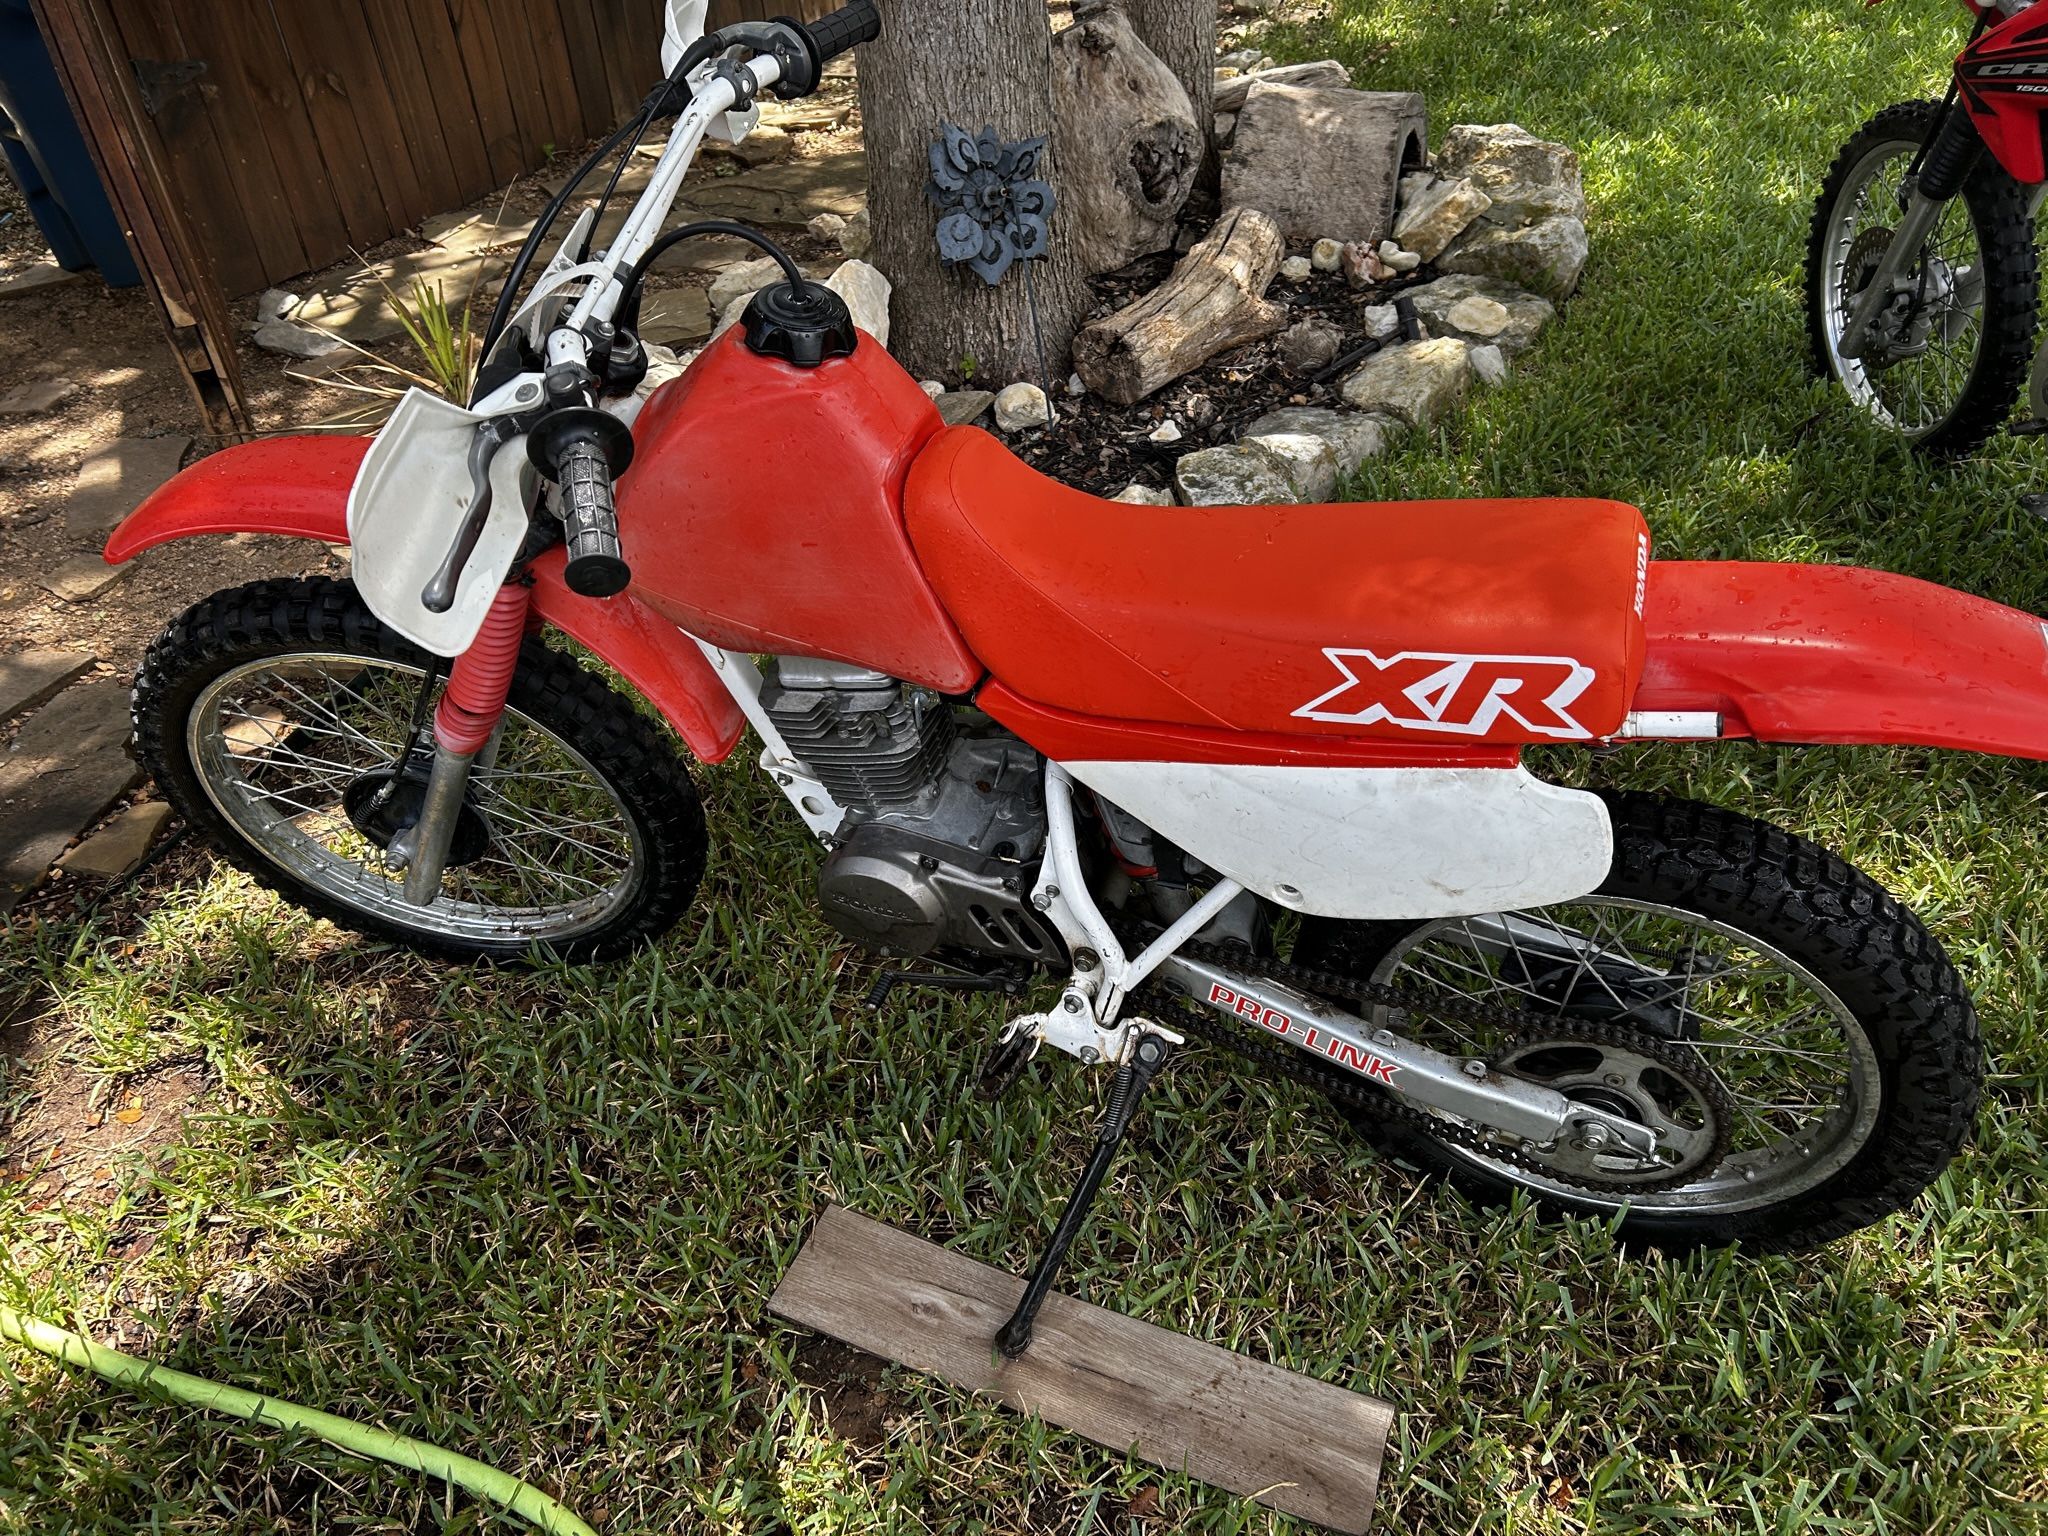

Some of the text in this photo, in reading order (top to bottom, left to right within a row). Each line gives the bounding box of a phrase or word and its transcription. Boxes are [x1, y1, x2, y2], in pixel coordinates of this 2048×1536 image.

[1977, 62, 2048, 76] CR
[2016, 84, 2048, 93] 150
[1634, 532, 1647, 621] HONDA
[1290, 647, 1596, 739] XR
[1208, 982, 1403, 1087] PRO-LINK
